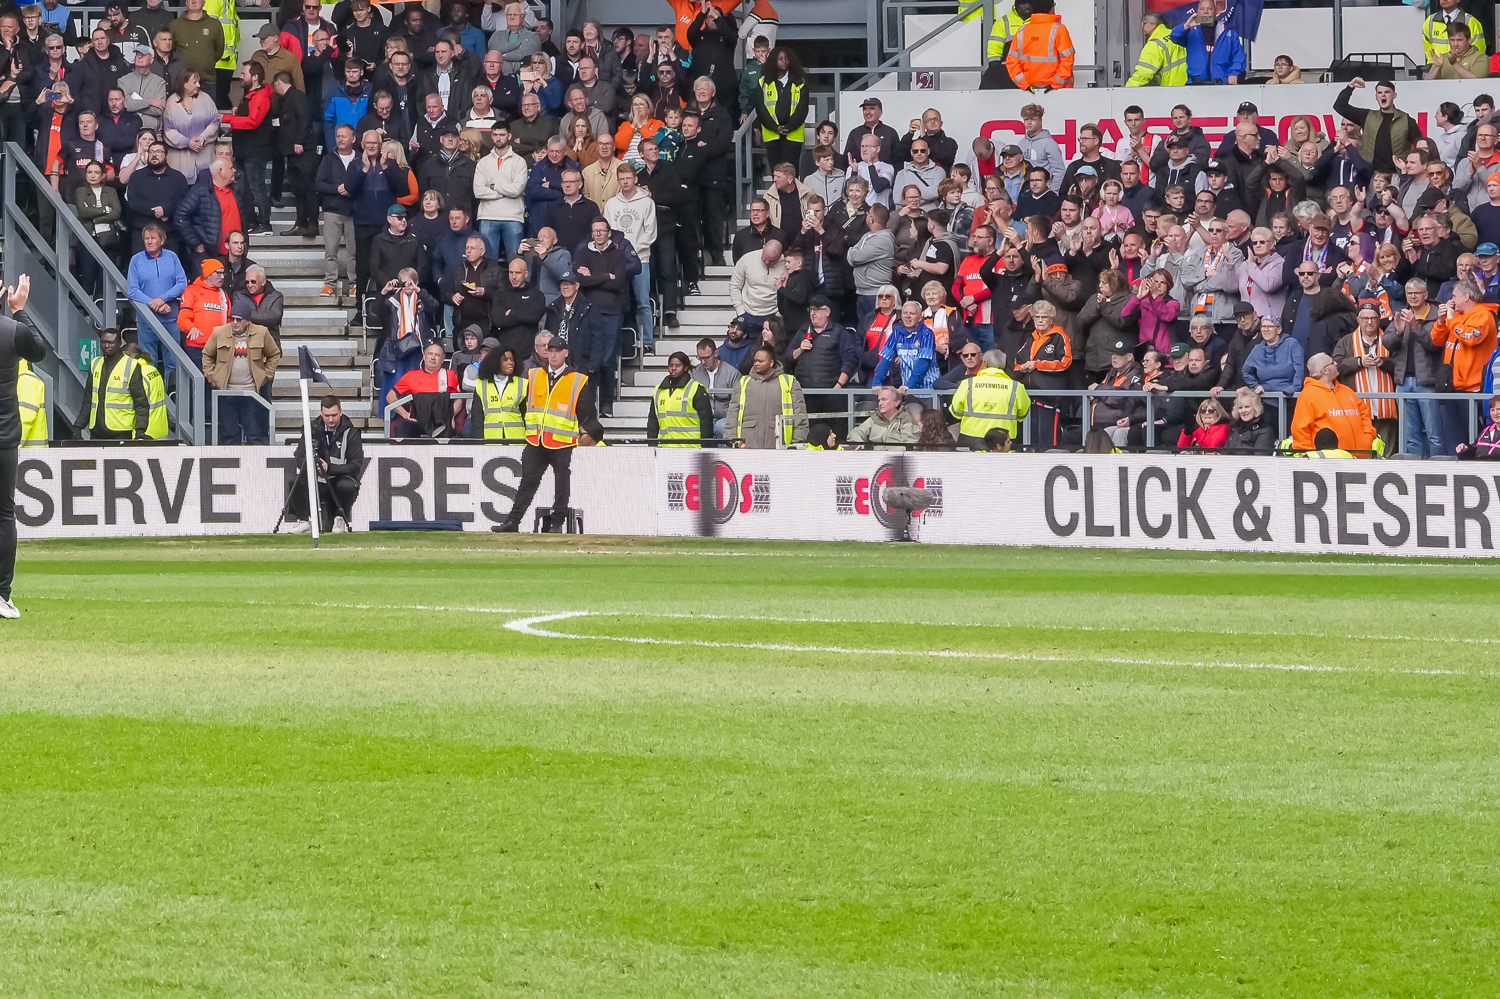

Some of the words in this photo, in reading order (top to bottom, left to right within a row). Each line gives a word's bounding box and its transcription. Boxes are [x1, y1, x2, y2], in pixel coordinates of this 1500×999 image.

[491, 394, 499, 403] 35
[974, 382, 1009, 390] SUPERVISOR
[266, 456, 523, 525] TRES
[1043, 464, 1215, 539] CLICK
[1232, 468, 1273, 542] &
[1293, 471, 1500, 550] RESER
